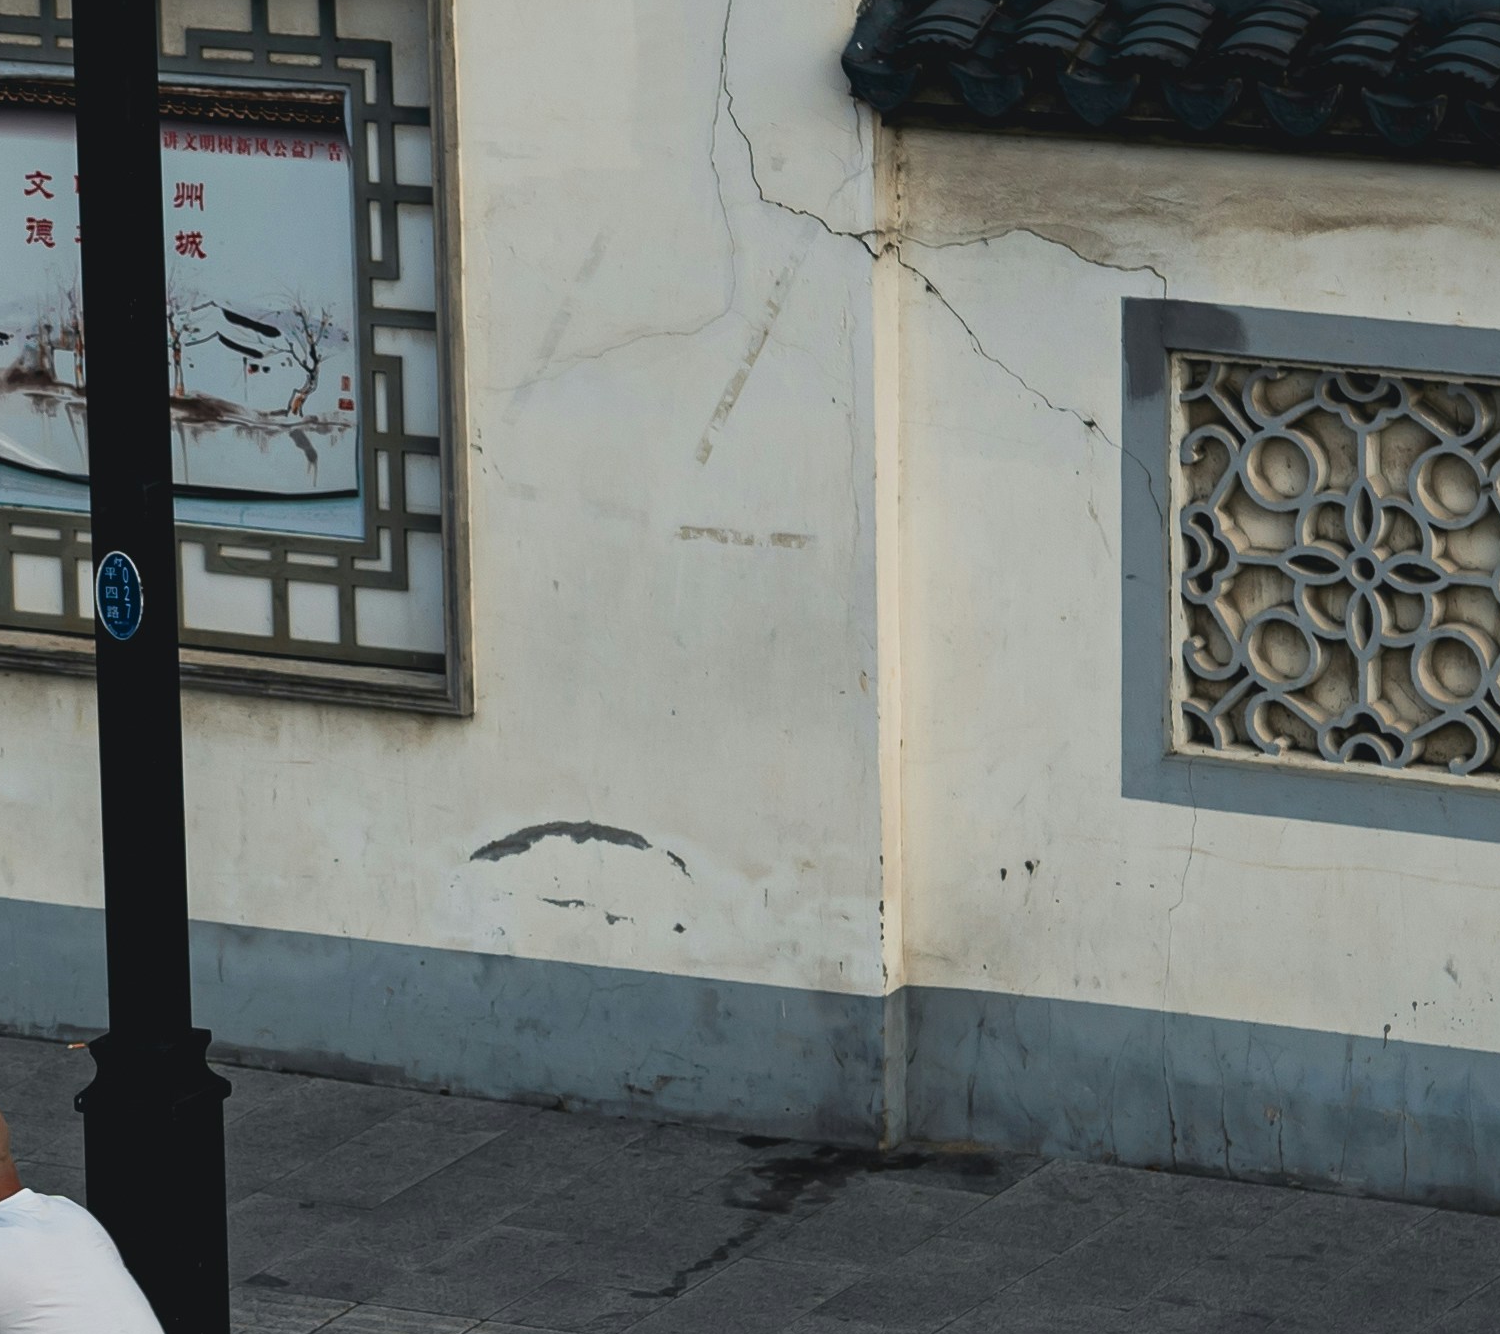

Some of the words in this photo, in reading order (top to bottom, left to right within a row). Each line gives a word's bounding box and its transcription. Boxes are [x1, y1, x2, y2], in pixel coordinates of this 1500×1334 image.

[163, 131, 343, 162] 讲文明树新风公益广告
